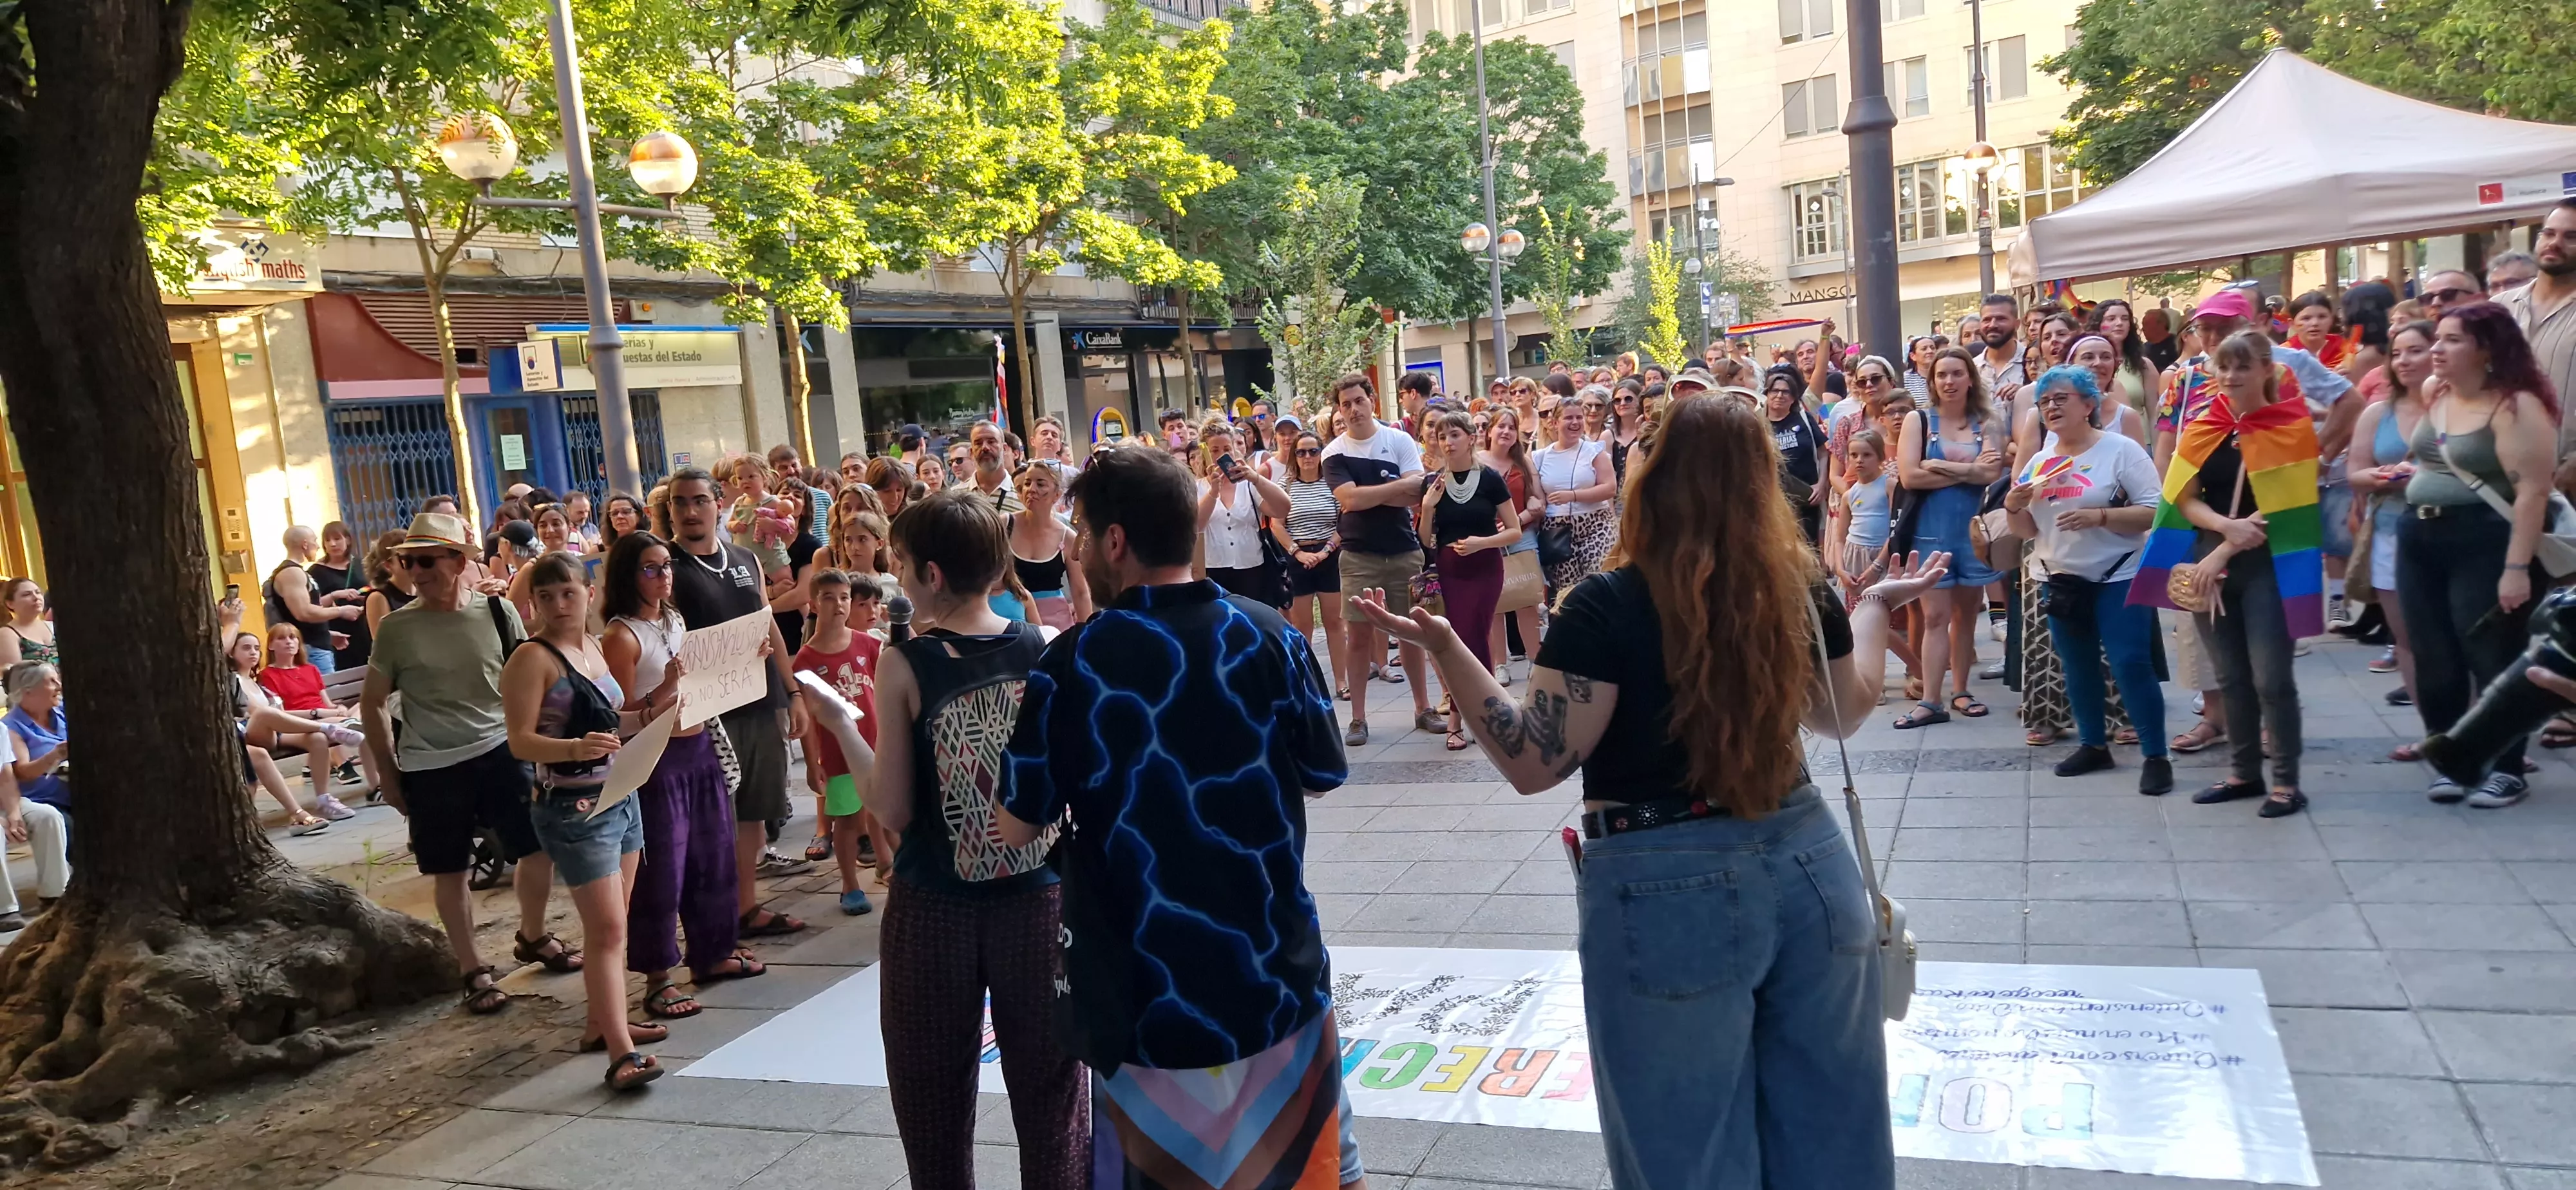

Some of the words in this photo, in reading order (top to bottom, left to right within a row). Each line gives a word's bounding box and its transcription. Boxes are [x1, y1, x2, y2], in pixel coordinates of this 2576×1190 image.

[262, 259, 305, 279] maths
[1790, 285, 1852, 303] MANGO
[649, 339, 654, 350] y
[1086, 332, 1122, 345] CaixaBank
[656, 350, 669, 362] del
[672, 350, 702, 362] Estado
[699, 685, 713, 702] NO
[717, 661, 752, 699] SERÁ
